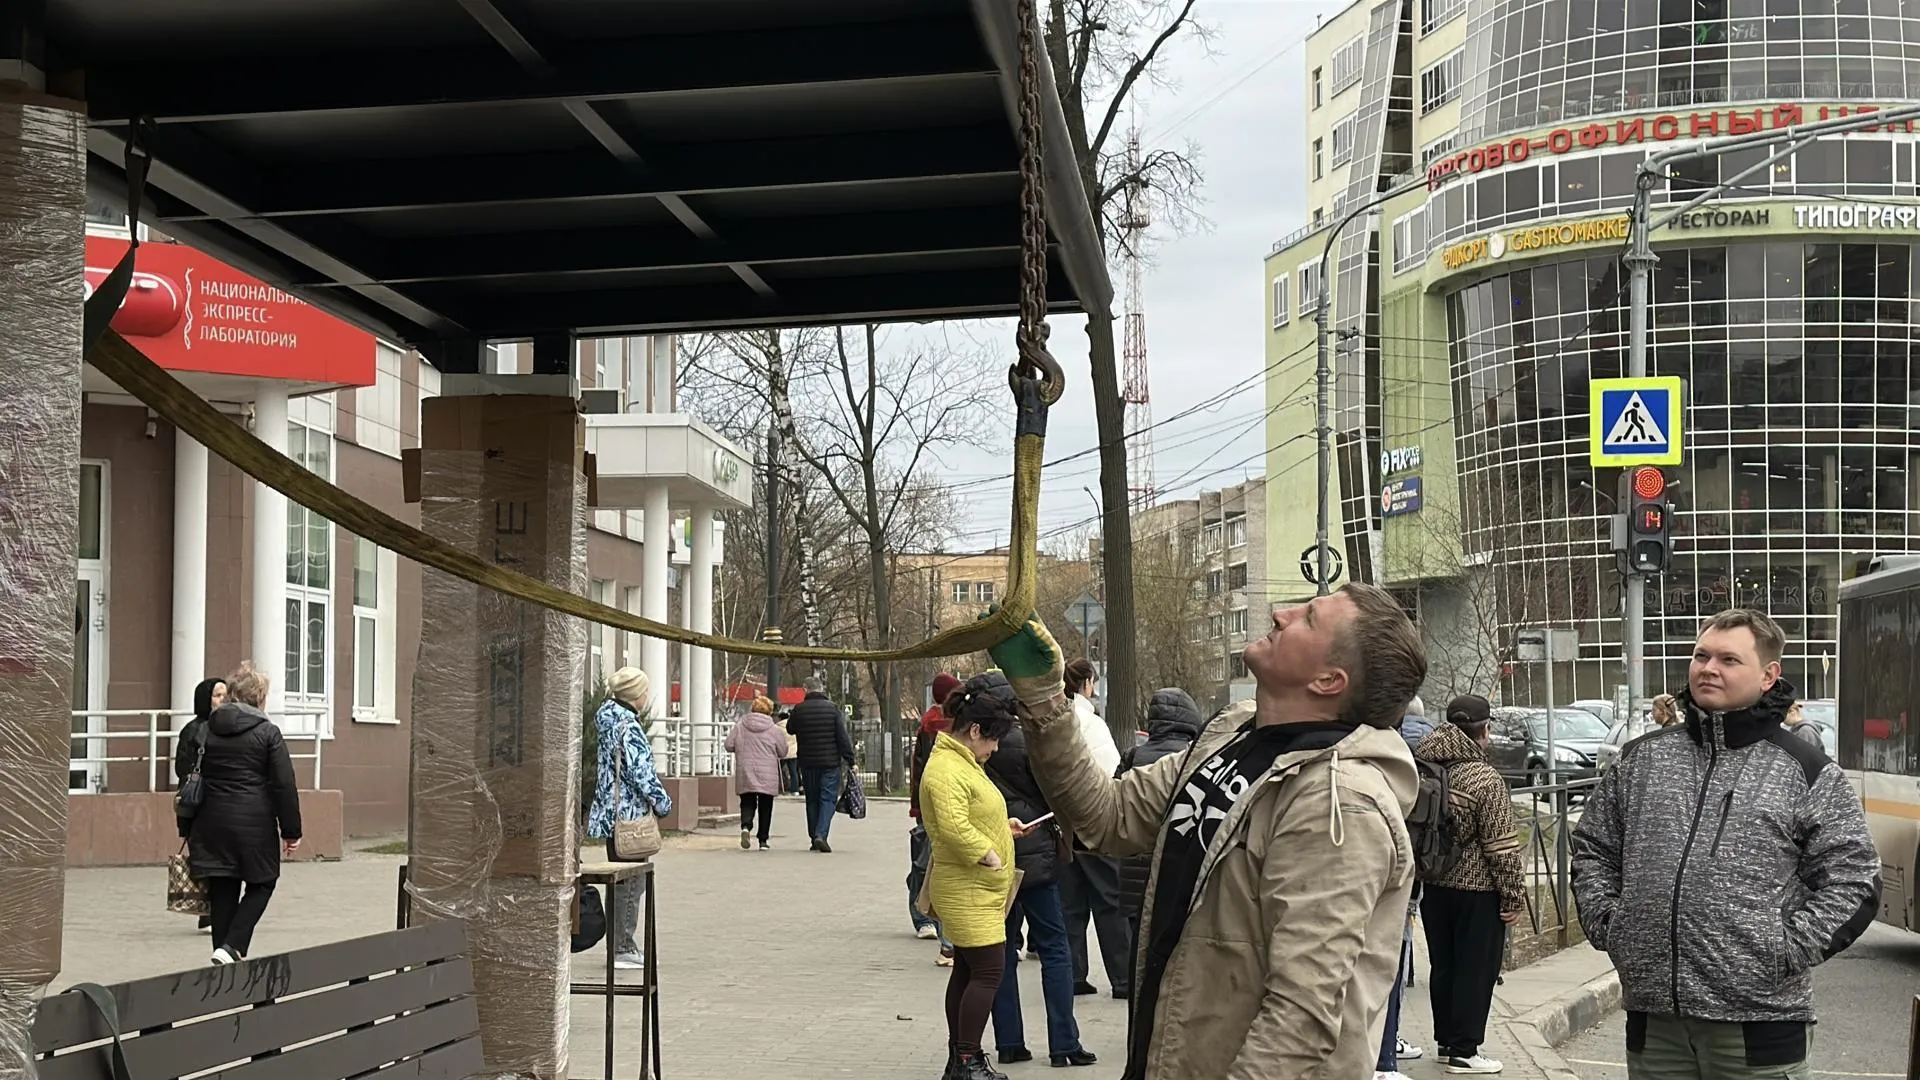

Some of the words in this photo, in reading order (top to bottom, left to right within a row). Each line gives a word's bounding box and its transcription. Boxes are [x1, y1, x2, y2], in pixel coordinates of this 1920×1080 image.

[1668, 209, 1770, 230] РЕСТОРАН
[1794, 205, 1920, 229] ТИПОГРАФ
[1511, 216, 1631, 252] GASTROMARKE
[201, 280, 307, 306] НАЦИОНАЛЬН
[201, 303, 273, 324] ЭКСПРЕСС-
[200, 326, 297, 348] ЛАБОРАТОРИЯ
